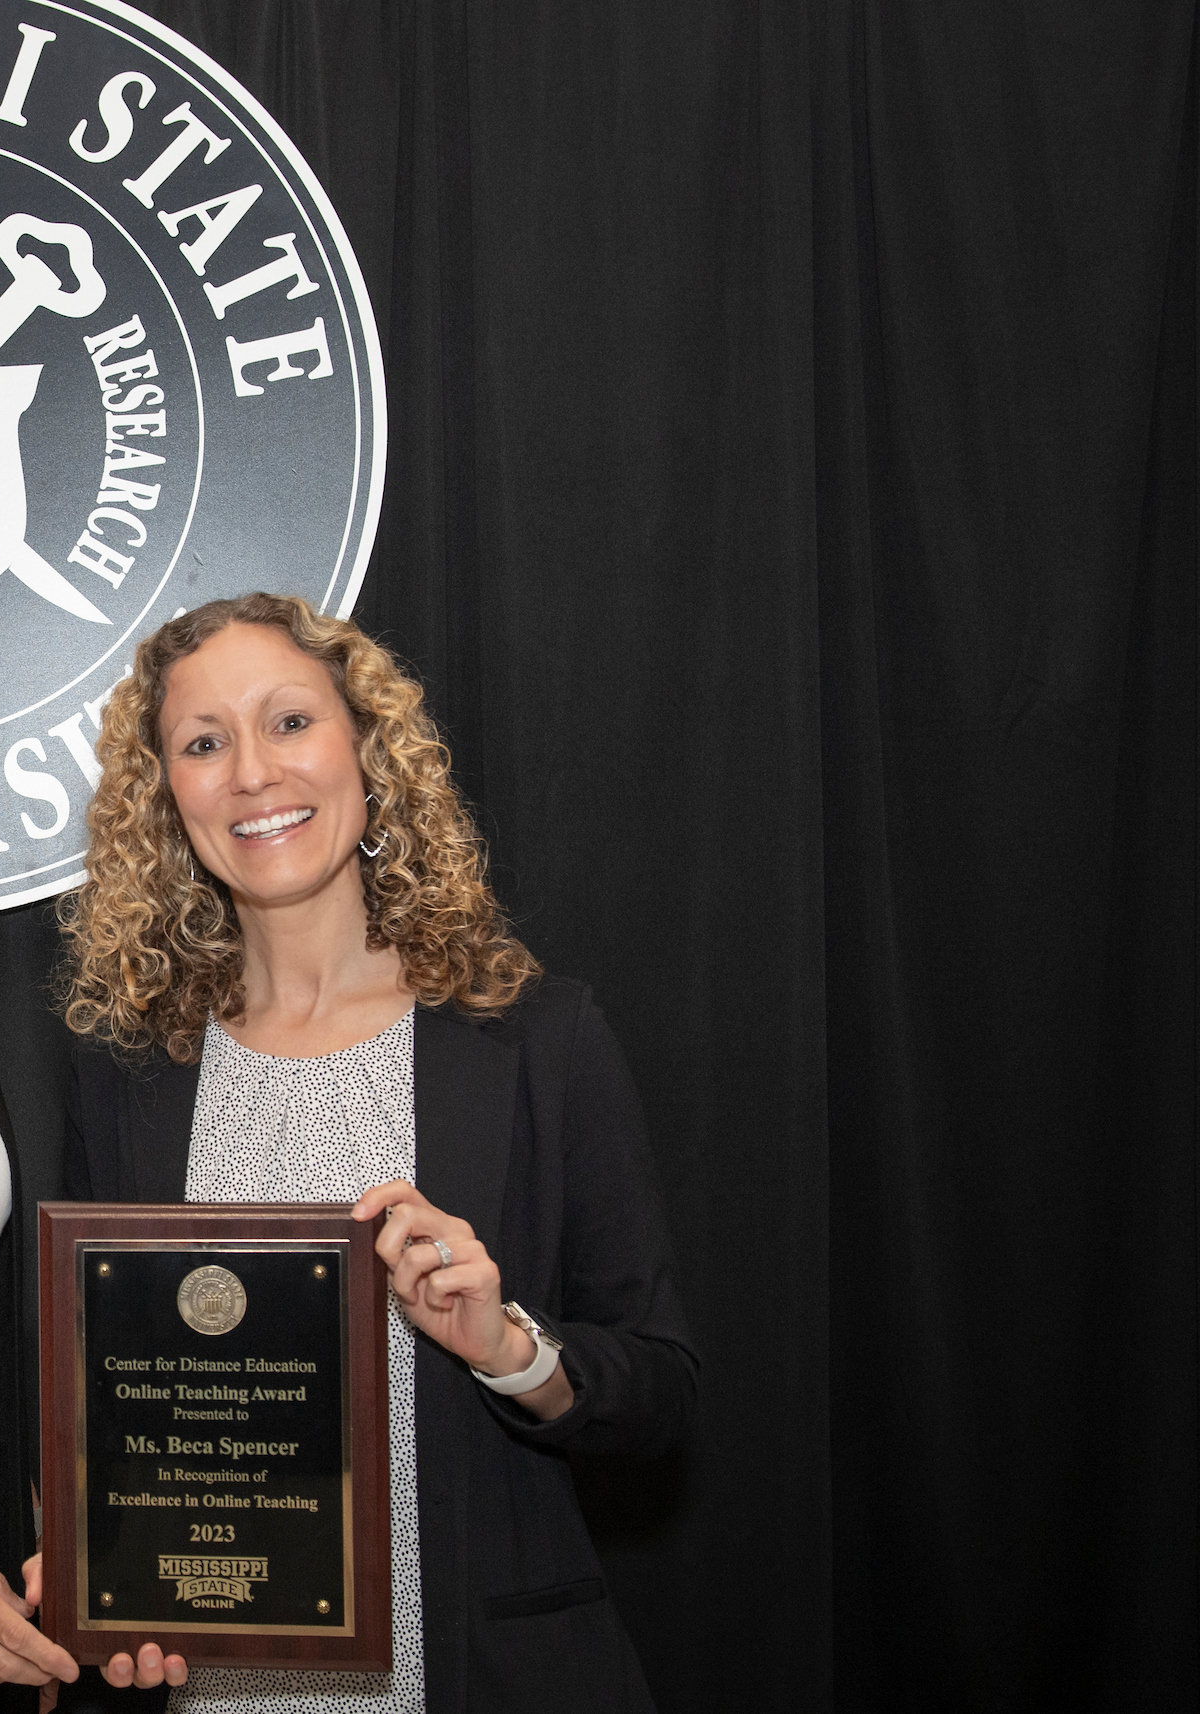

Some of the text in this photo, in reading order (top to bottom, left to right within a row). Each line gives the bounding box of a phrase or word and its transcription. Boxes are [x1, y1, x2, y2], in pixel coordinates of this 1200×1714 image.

[69, 70, 333, 397] STATE
[69, 314, 167, 590] RESEARCH
[104, 1356, 317, 1373] Center for Distance Education
[115, 1384, 307, 1404] Online Teaching Award
[173, 1407, 249, 1421] Presented to
[125, 1435, 299, 1459] Ms. Beca Spencer
[158, 1468, 268, 1484] In Recognition of
[108, 1492, 318, 1512] Excellence in Online Teaching
[189, 1524, 236, 1542] 2023
[158, 1558, 268, 1577] MISSISSIPPI
[189, 1580, 238, 1595] STATE
[192, 1599, 235, 1609] ONLINE
